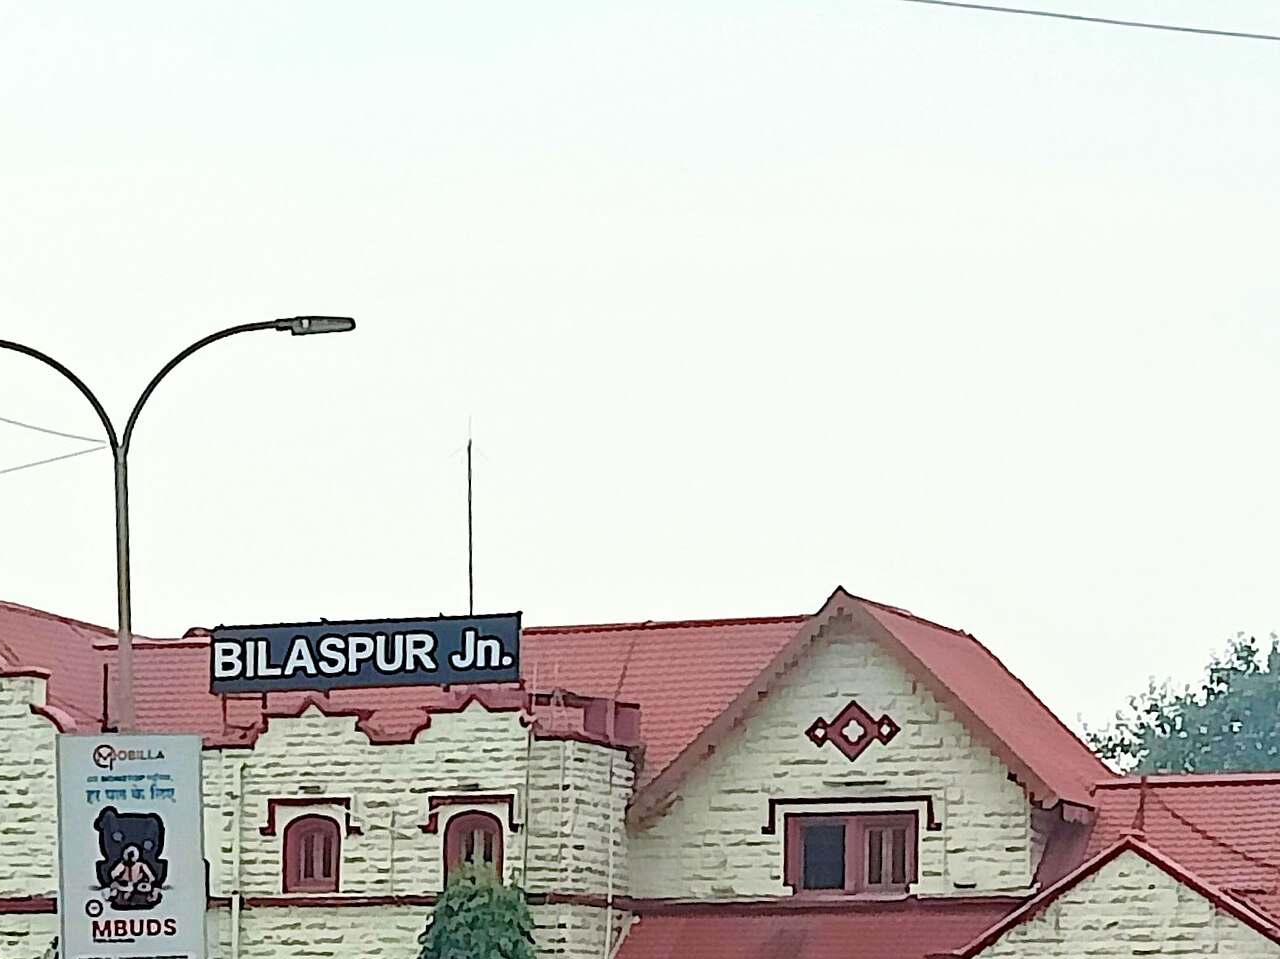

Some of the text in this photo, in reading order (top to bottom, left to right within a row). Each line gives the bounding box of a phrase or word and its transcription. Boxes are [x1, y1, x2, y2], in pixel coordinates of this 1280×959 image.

[214, 630, 513, 678] BILASPUR Jn.
[92, 919, 177, 938] MBUDS
